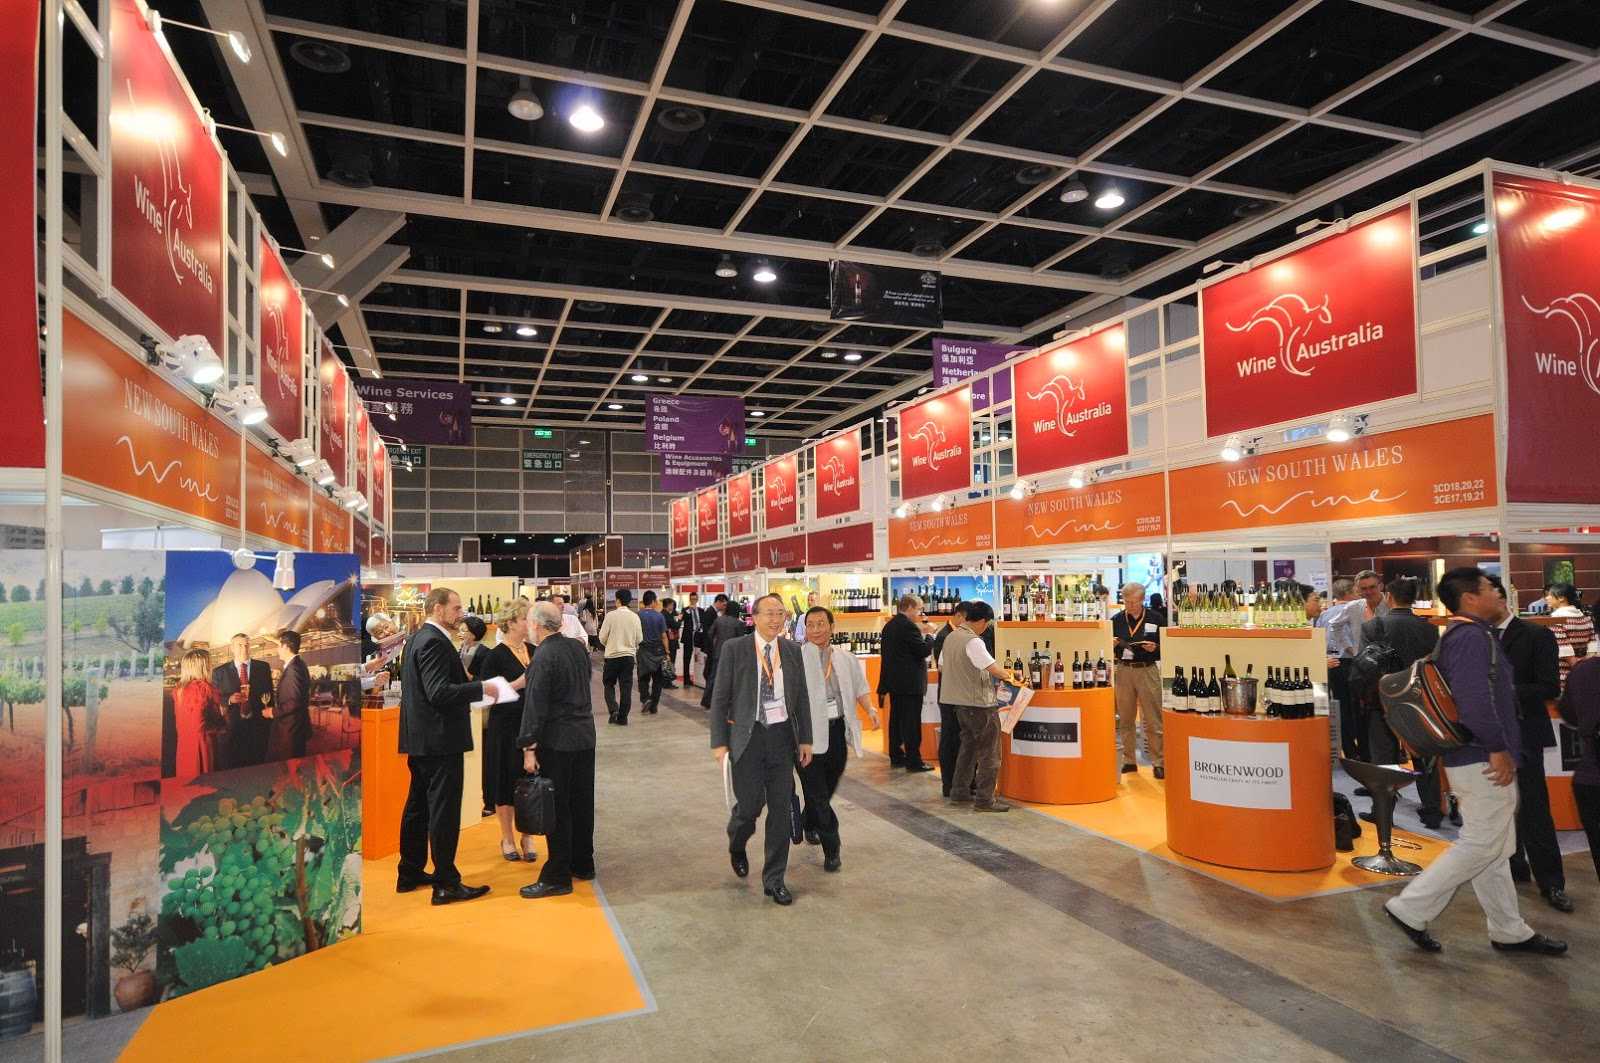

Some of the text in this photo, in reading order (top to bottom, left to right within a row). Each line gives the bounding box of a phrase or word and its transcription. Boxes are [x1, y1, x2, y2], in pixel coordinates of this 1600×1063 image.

[134, 174, 213, 297] Wine Australia
[942, 344, 977, 355] Bulgaria
[1236, 322, 1384, 378] Wine Australia
[1535, 351, 1577, 377] Wine
[357, 384, 454, 400] Wine Services
[124, 377, 219, 460] NEW SOUTH WALES
[653, 415, 680, 423] Poland
[1033, 401, 1112, 434] Wine Australia
[653, 434, 685, 442] Belgium
[911, 445, 962, 468] Wine Australia
[1226, 444, 1404, 489] NEW SOUTH WALES
[1028, 489, 1122, 515] NEW SOUTH WALES
[1219, 488, 1408, 517] Wine
[1194, 760, 1284, 778] BROKENWOOD
